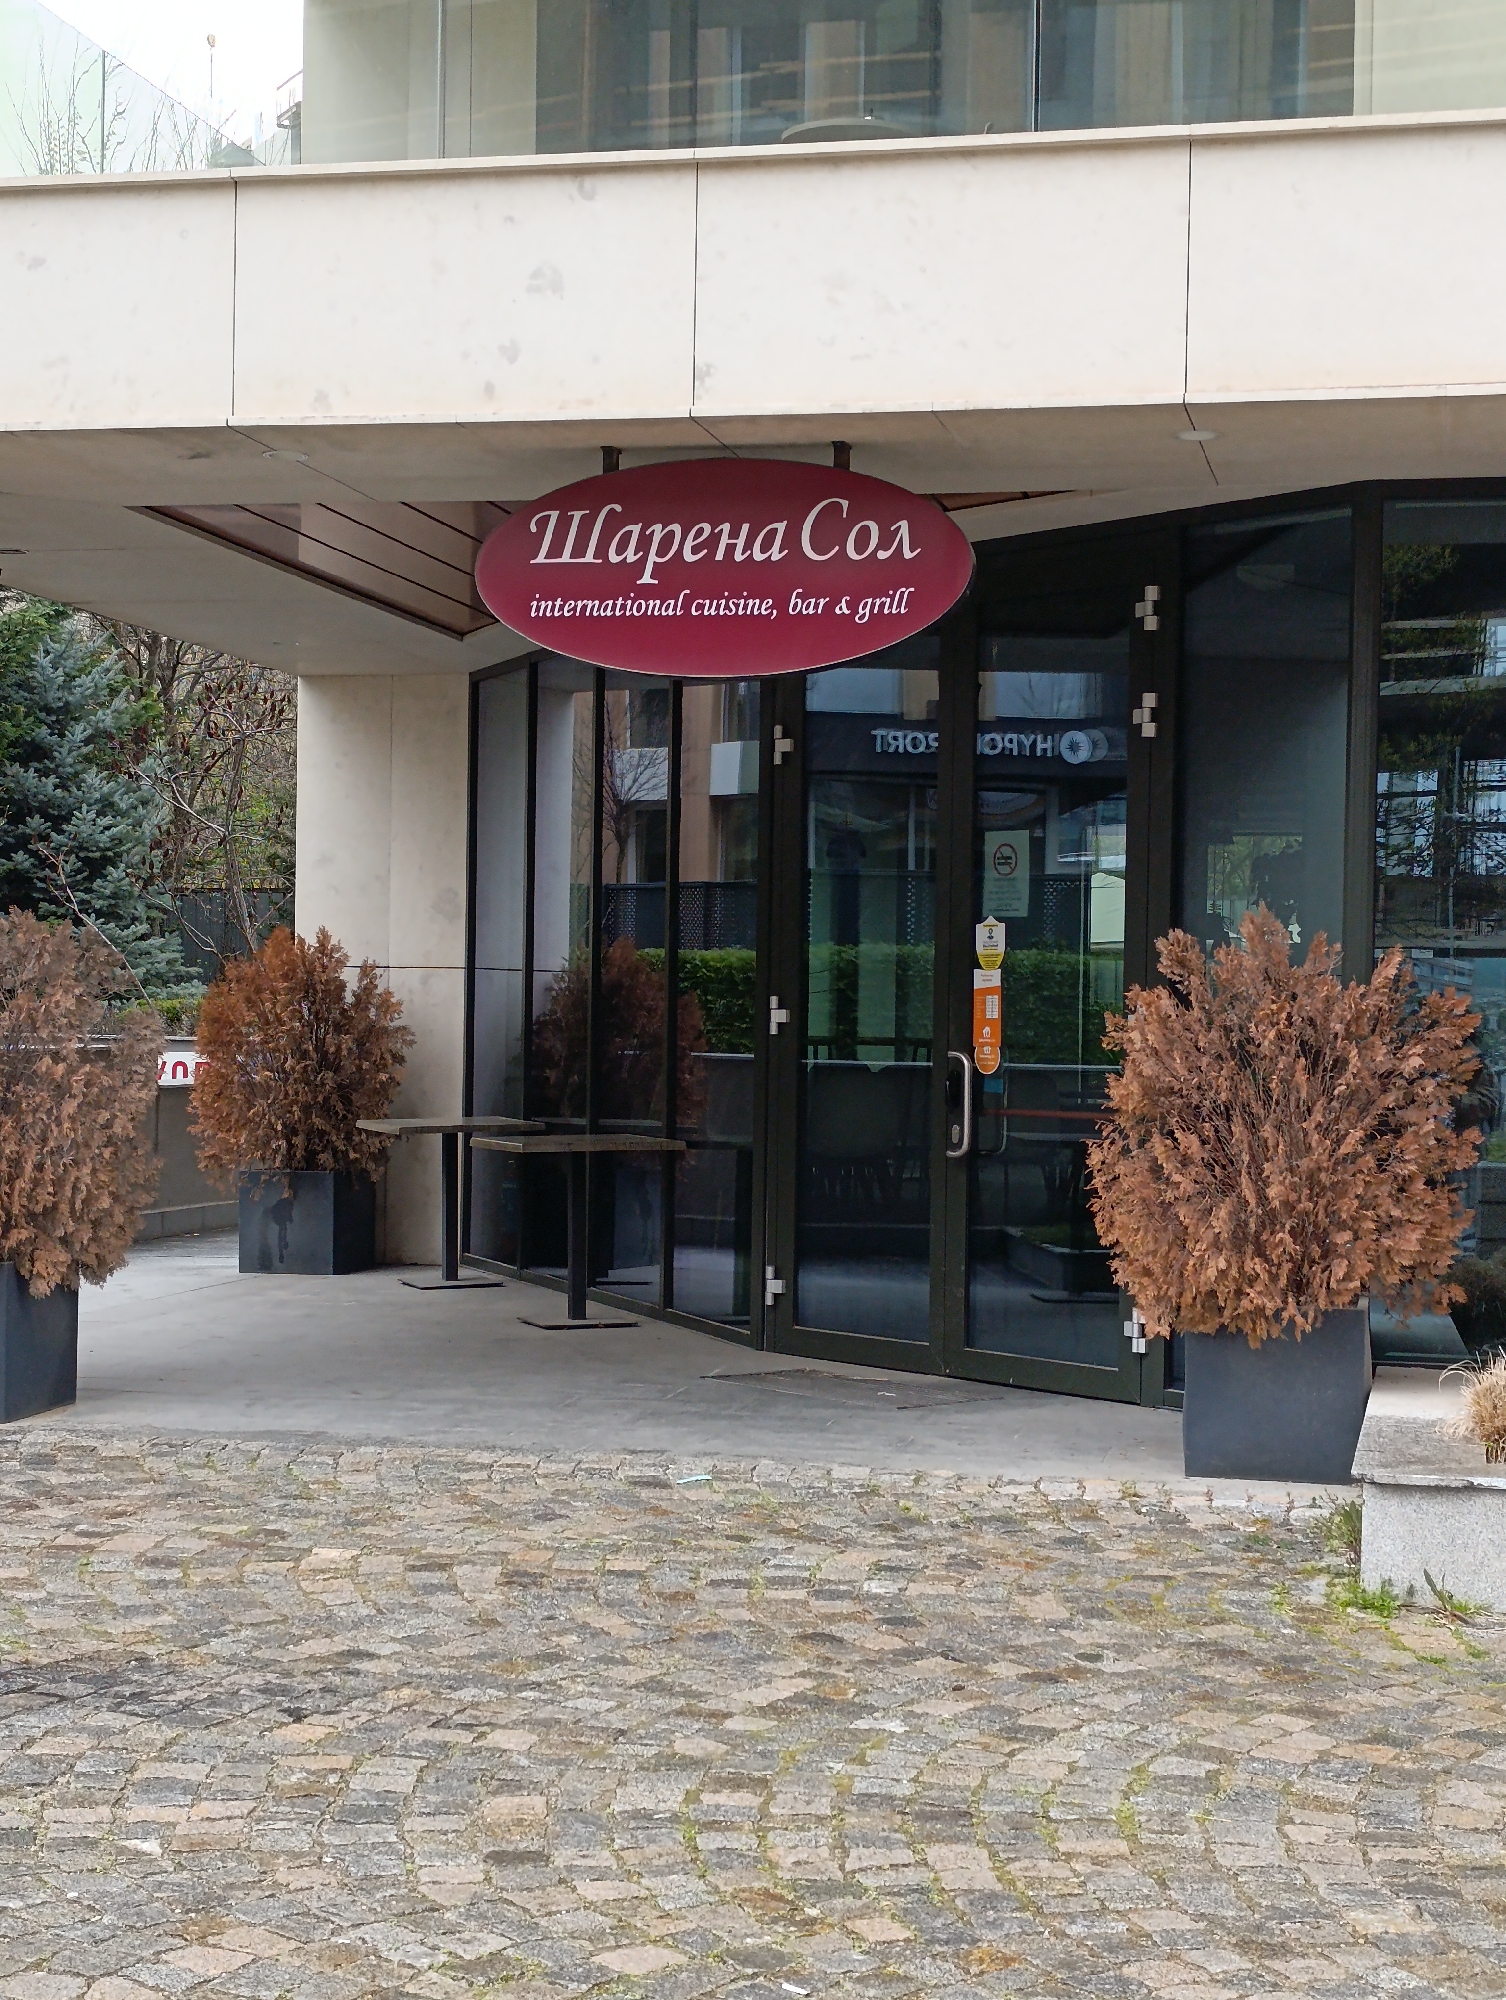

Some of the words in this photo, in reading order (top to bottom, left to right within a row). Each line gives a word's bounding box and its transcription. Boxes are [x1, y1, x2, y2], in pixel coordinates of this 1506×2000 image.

[528, 503, 790, 585] Шарена
[800, 497, 923, 562] Сол
[529, 588, 691, 618] international
[690, 590, 779, 621] cuisine,
[787, 587, 831, 616] bar
[834, 594, 853, 616] &
[853, 586, 916, 625] grill
